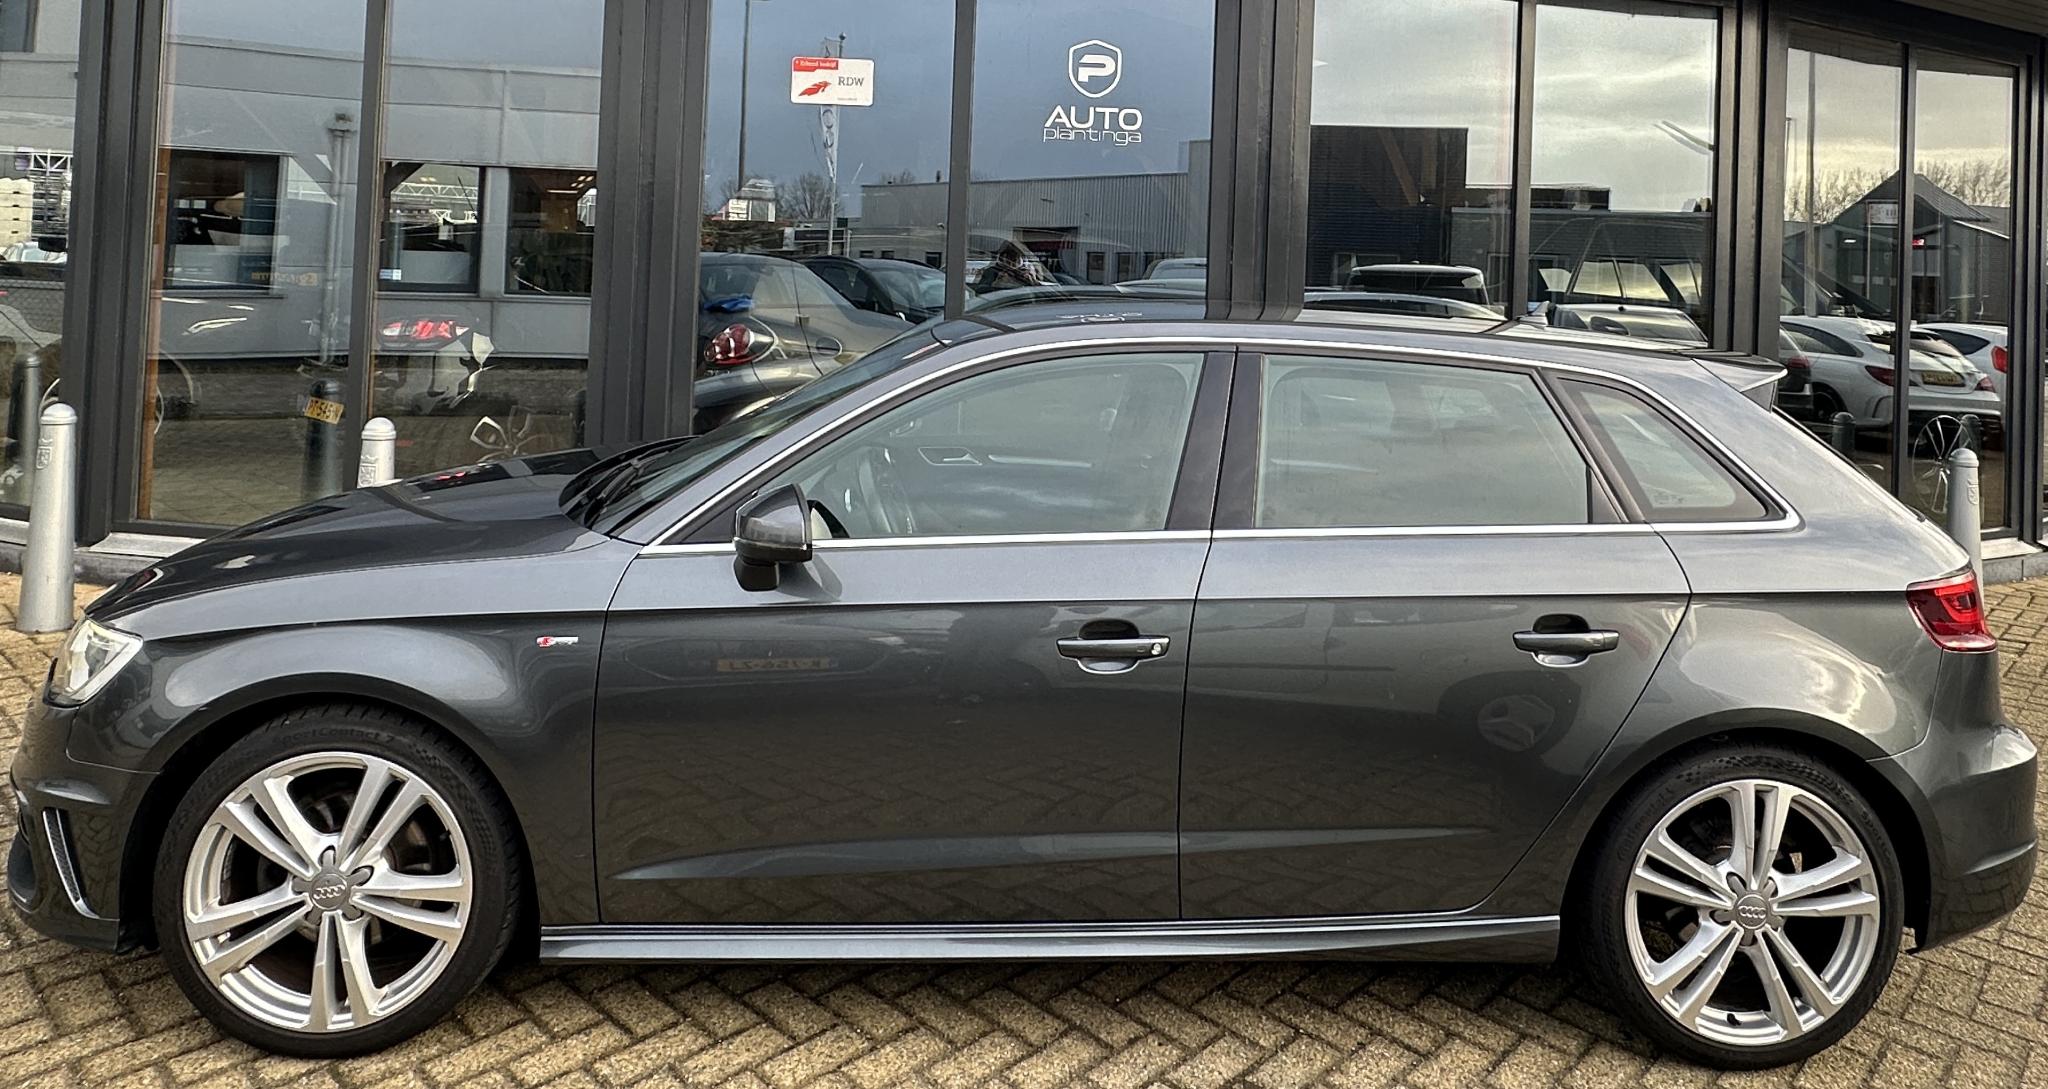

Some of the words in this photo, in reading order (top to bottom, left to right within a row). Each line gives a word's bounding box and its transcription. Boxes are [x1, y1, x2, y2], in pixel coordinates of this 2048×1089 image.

[1078, 54, 1116, 82] P
[838, 76, 864, 87] RDW
[1044, 105, 1143, 131] AUTO
[1043, 126, 1142, 146] plantinga
